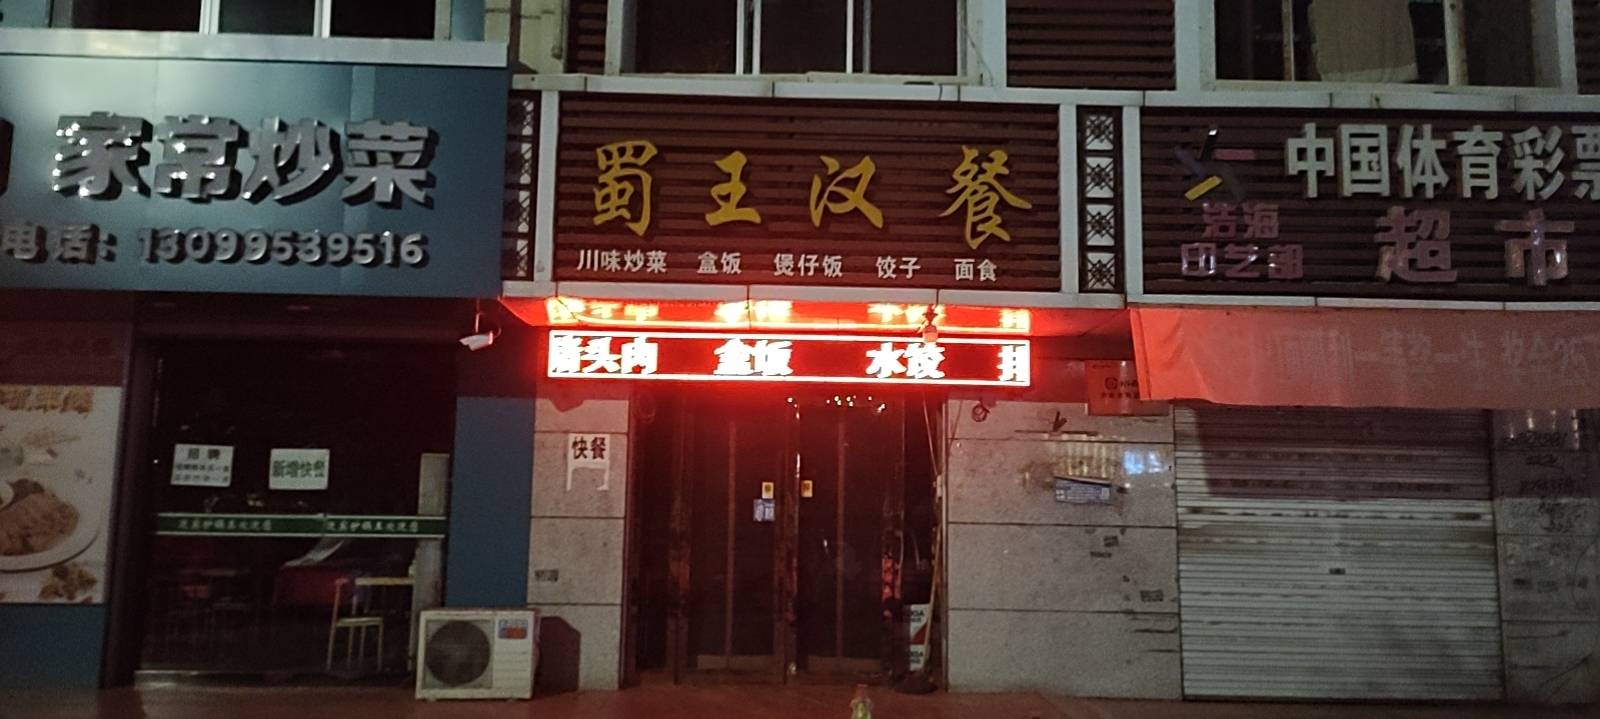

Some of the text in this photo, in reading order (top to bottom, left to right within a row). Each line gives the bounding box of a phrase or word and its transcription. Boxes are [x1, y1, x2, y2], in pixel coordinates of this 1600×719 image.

[53, 112, 435, 207] 家常炒菜
[1284, 121, 1600, 200] 中国体育彩票
[592, 139, 1032, 249] 蜀王汉餐
[1202, 202, 1280, 239] 浩海
[138, 228, 428, 267] 13099539516
[576, 249, 998, 283] 川味炒菜 盒饭 煲仔饭 饺子 面食
[1374, 205, 1575, 286] 超市
[713, 338, 793, 377] 盒饭
[865, 342, 945, 380] 水饺
[571, 436, 607, 461] 快餐
